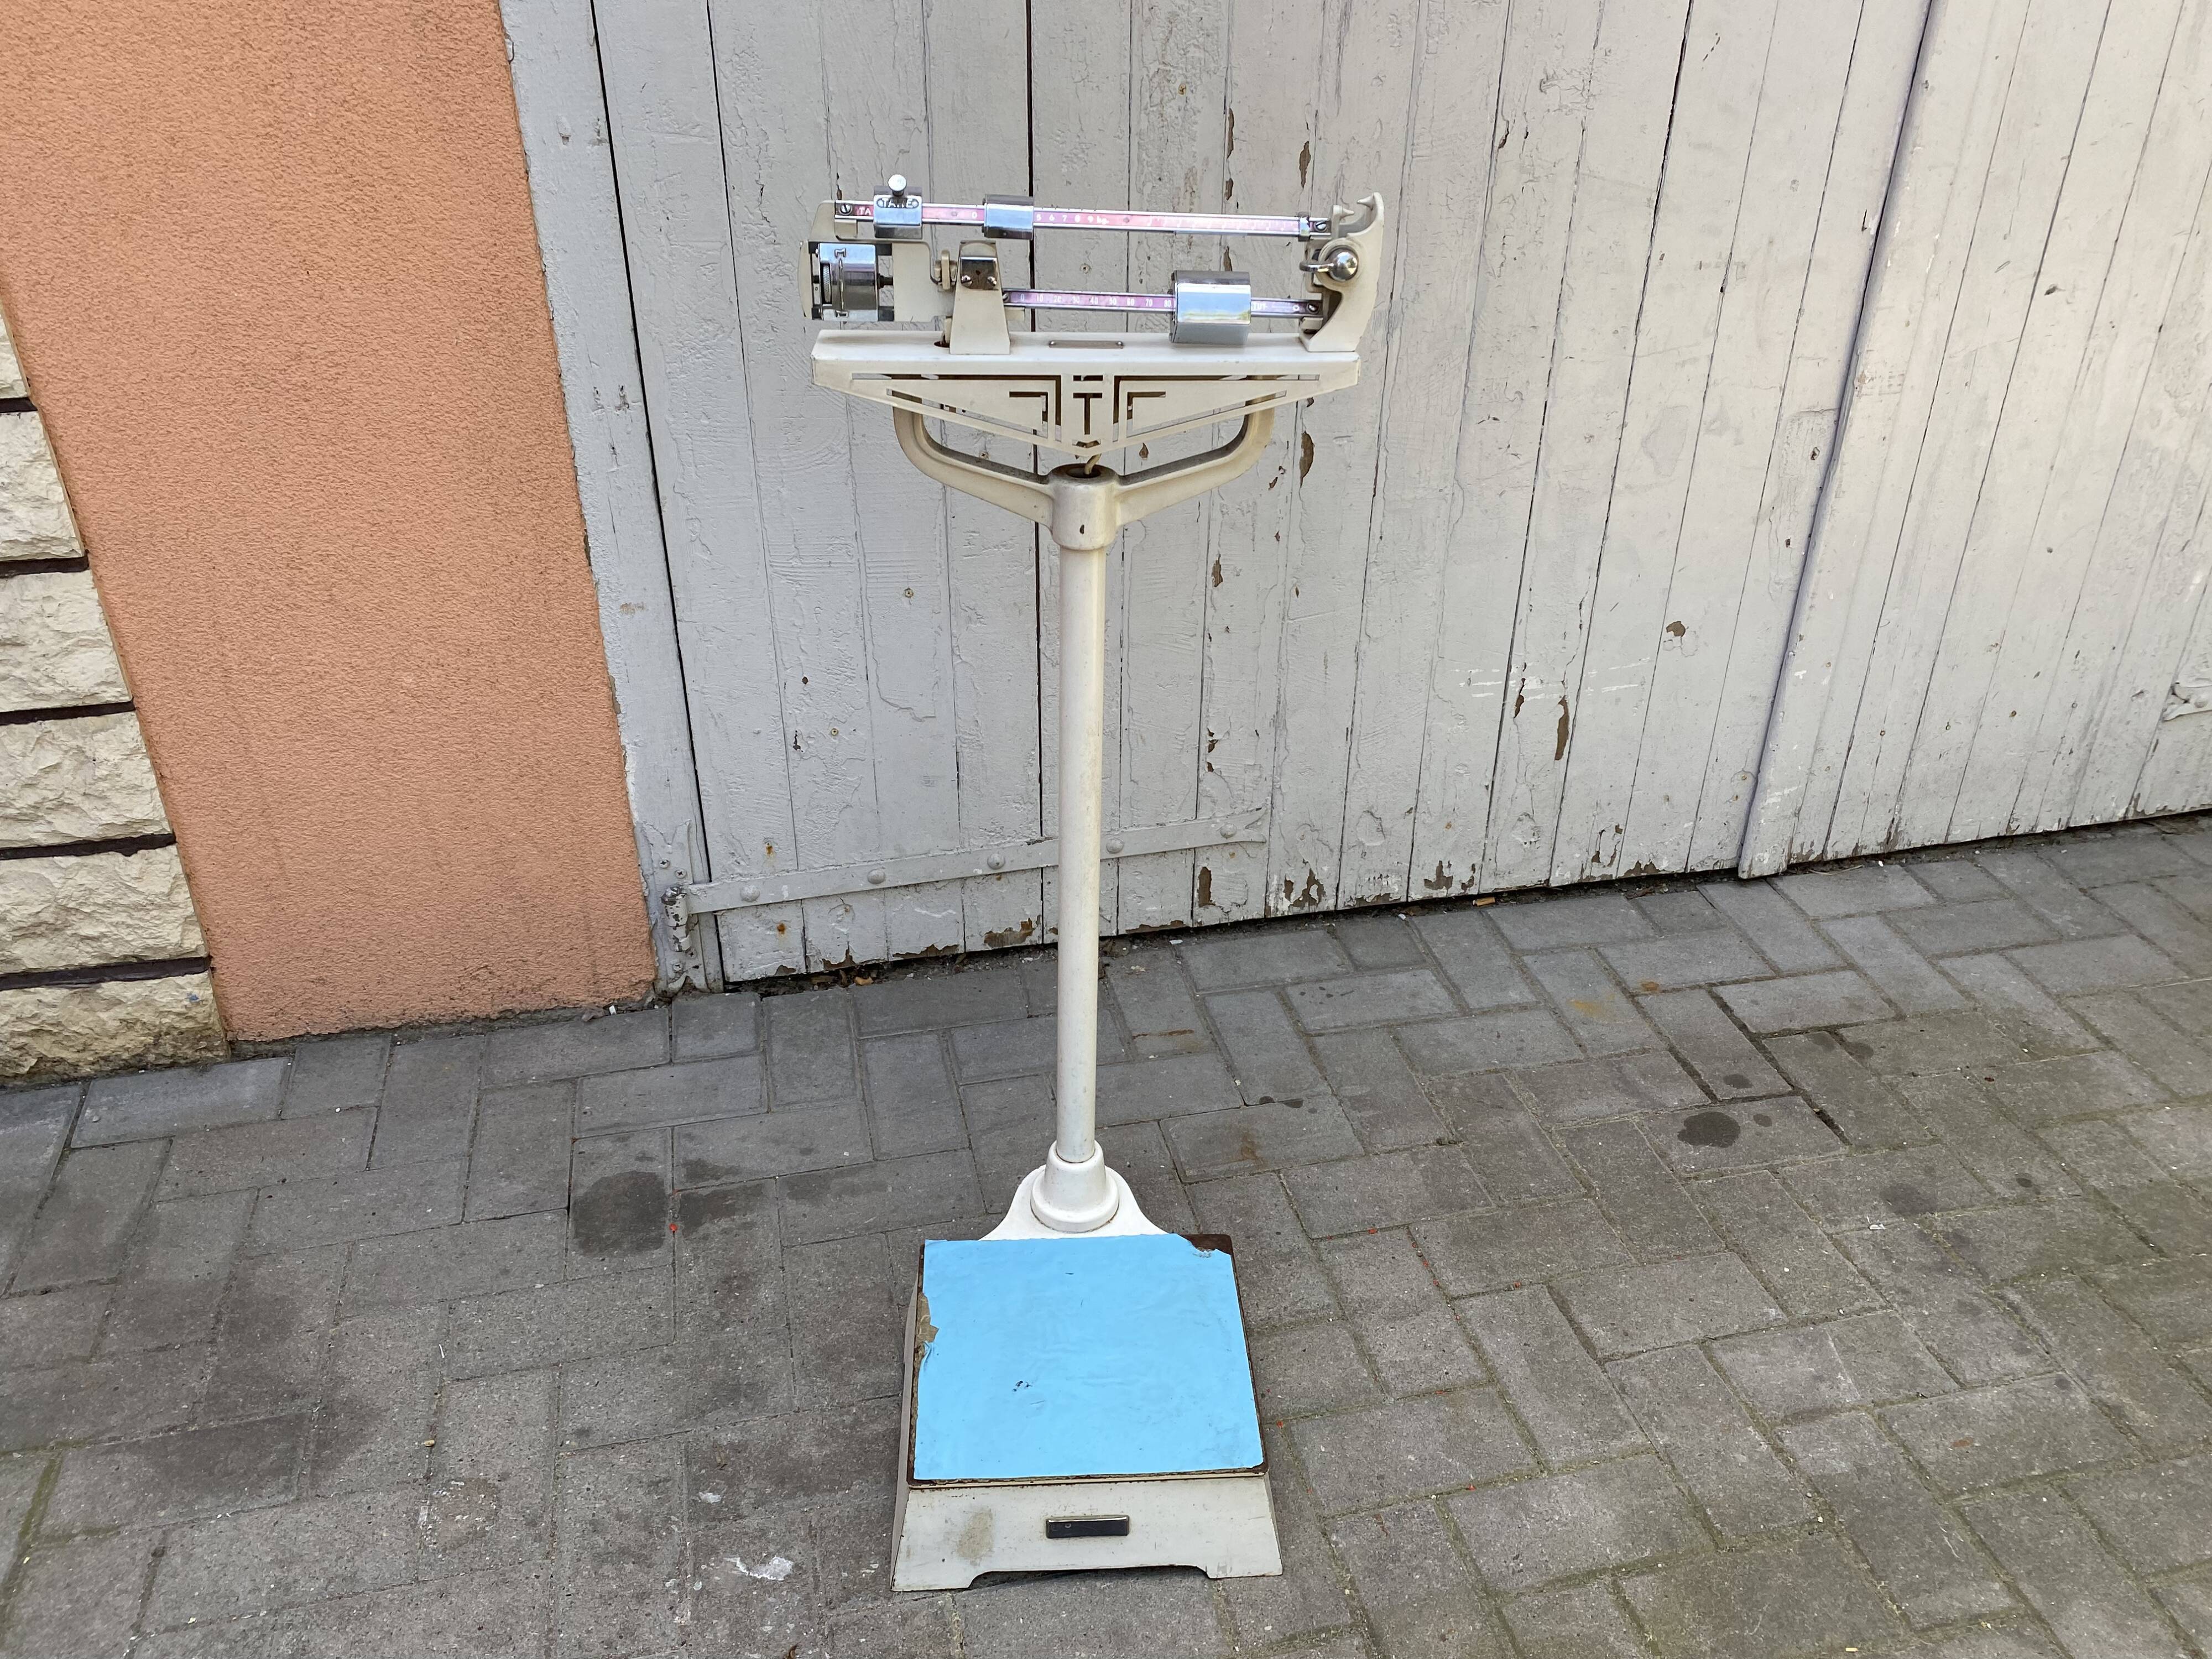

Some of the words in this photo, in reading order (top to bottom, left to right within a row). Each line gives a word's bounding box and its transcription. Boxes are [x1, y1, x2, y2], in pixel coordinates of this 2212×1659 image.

[1074, 214, 1081, 222] 8
[1072, 295, 1080, 304] 30
[1090, 296, 1098, 304] 40
[1127, 298, 1135, 306] 60
[1145, 299, 1153, 307] 70
[1164, 299, 1171, 307] 80
